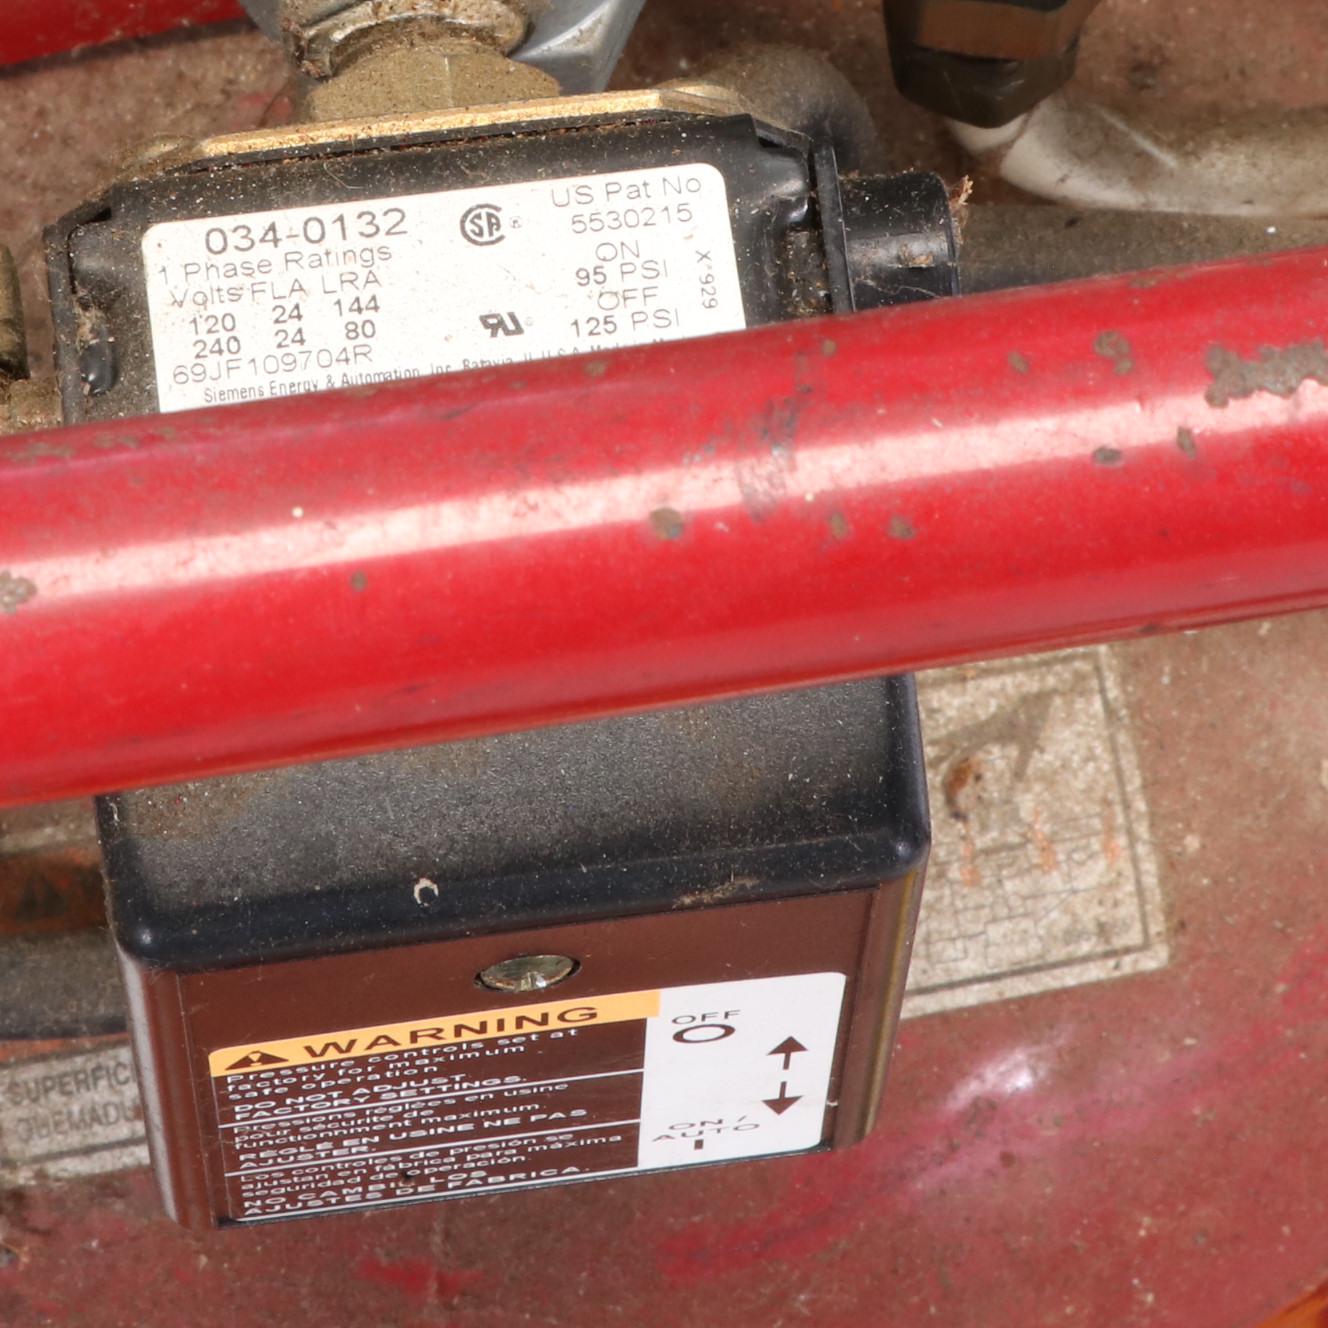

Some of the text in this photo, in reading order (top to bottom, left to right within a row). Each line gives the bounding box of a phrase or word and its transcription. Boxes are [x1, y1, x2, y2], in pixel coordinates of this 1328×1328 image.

[551, 176, 702, 208] US Pat No
[205, 208, 408, 255] 034-0132
[571, 203, 693, 234] 5530215
[158, 244, 392, 285] 1 Phase Ratings
[595, 241, 641, 262] ON
[171, 271, 382, 309] Volts FLA LRA
[575, 259, 669, 286] 95 PSI
[189, 295, 381, 335] 120 24 144
[597, 286, 659, 311] OFF
[193, 320, 376, 359] 240 24 80
[571, 308, 680, 337] 125 PSI
[173, 344, 373, 385] 69JF109704R
[204, 379, 265, 403] Siemens
[270, 376, 318, 395] Energy
[326, 375, 335, 388] &
[340, 366, 421, 386] Automation
[304, 1007, 597, 1058] WARNING
[672, 1010, 740, 1024] OFF
[227, 1029, 578, 1083] Pressure controls set at
[227, 1045, 524, 1093] factory for maximum
[229, 1066, 437, 1100] safe operation
[234, 1091, 343, 1112] DO NOT
[235, 1075, 527, 1120] FACTORY SETTINGS.
[234, 1111, 356, 1134] Pressions
[465, 1093, 494, 1103] en
[504, 1083, 568, 1097] usine
[235, 1108, 434, 1145] pour de
[669, 1119, 723, 1130] ON
[343, 1136, 379, 1147] EN
[390, 1123, 474, 1140] USINE
[484, 1117, 520, 1128] NE
[530, 1109, 587, 1121] PAS
[652, 1123, 760, 1142] AUTO
[240, 1146, 376, 1169] AJUSTER.
[241, 1134, 573, 1182] Los controles de presión se
[241, 1174, 329, 1191] ajustan
[338, 1168, 367, 1177] en
[467, 1148, 517, 1161] para
[528, 1135, 621, 1152] máxima
[242, 1171, 398, 1199] seguridad de
[244, 1170, 487, 1208] NO LOS
[245, 1192, 382, 1215] AJUSTES
[396, 1185, 435, 1196] DE
